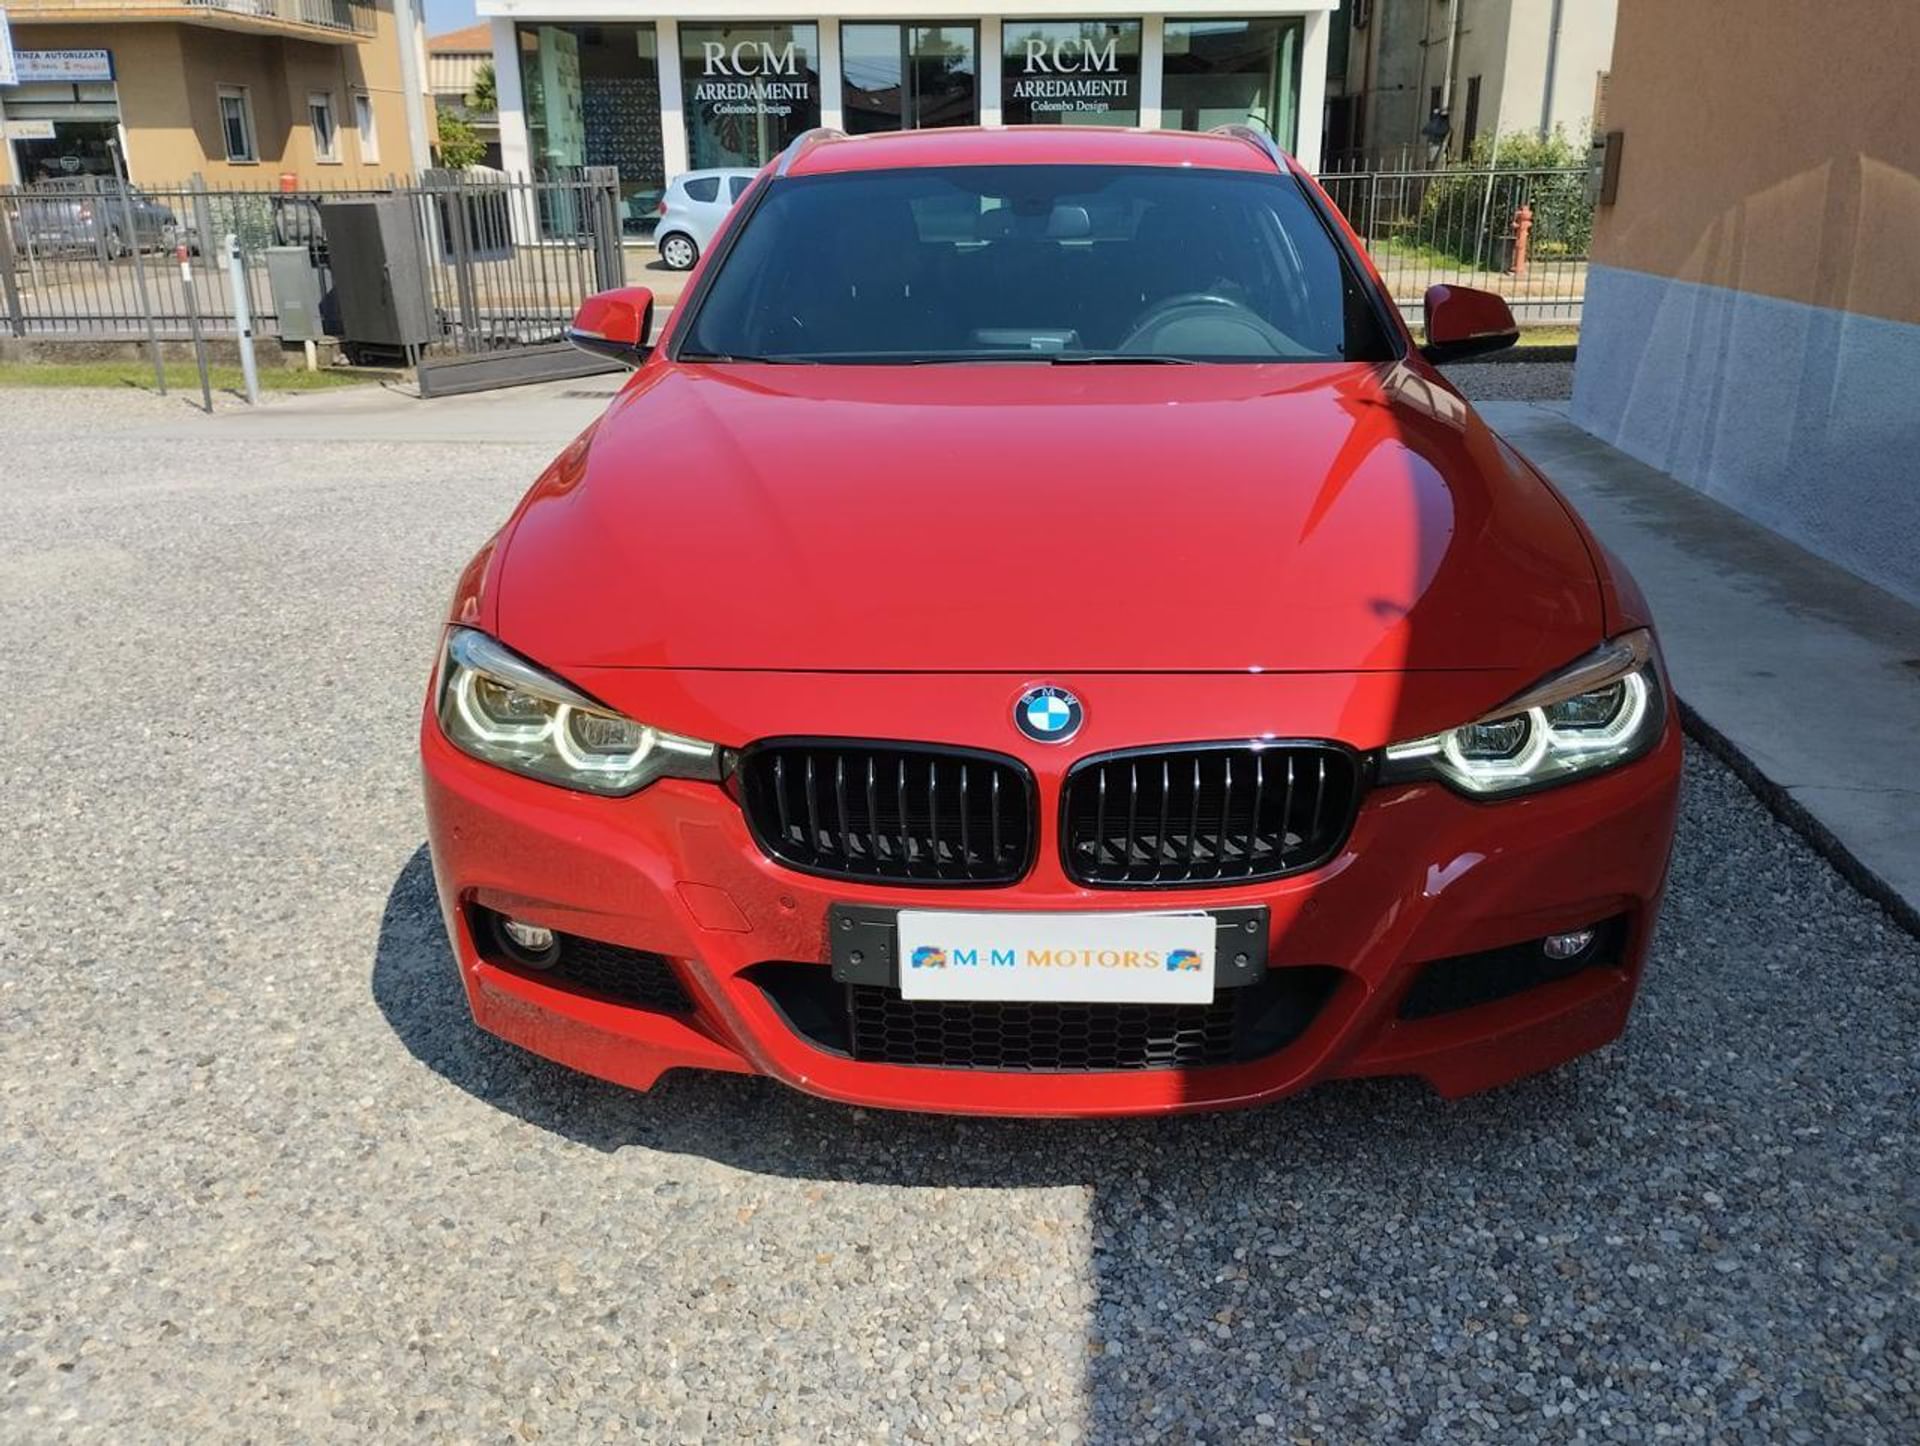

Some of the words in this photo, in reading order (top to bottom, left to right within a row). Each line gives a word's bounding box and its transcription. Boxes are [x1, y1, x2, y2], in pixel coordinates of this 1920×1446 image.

[702, 41, 799, 75] RCM
[1023, 38, 1119, 72] RCM
[695, 83, 808, 100] ARREDAMENTI
[1013, 80, 1128, 97] ARREDAMENTI
[713, 103, 757, 114] Colombo
[760, 103, 792, 116] Design
[1030, 101, 1074, 112] Colombo
[1076, 101, 1109, 113] Design
[1021, 687, 1078, 706] BMW
[953, 949, 1015, 967] M-M
[1026, 949, 1160, 969] MOTORS
